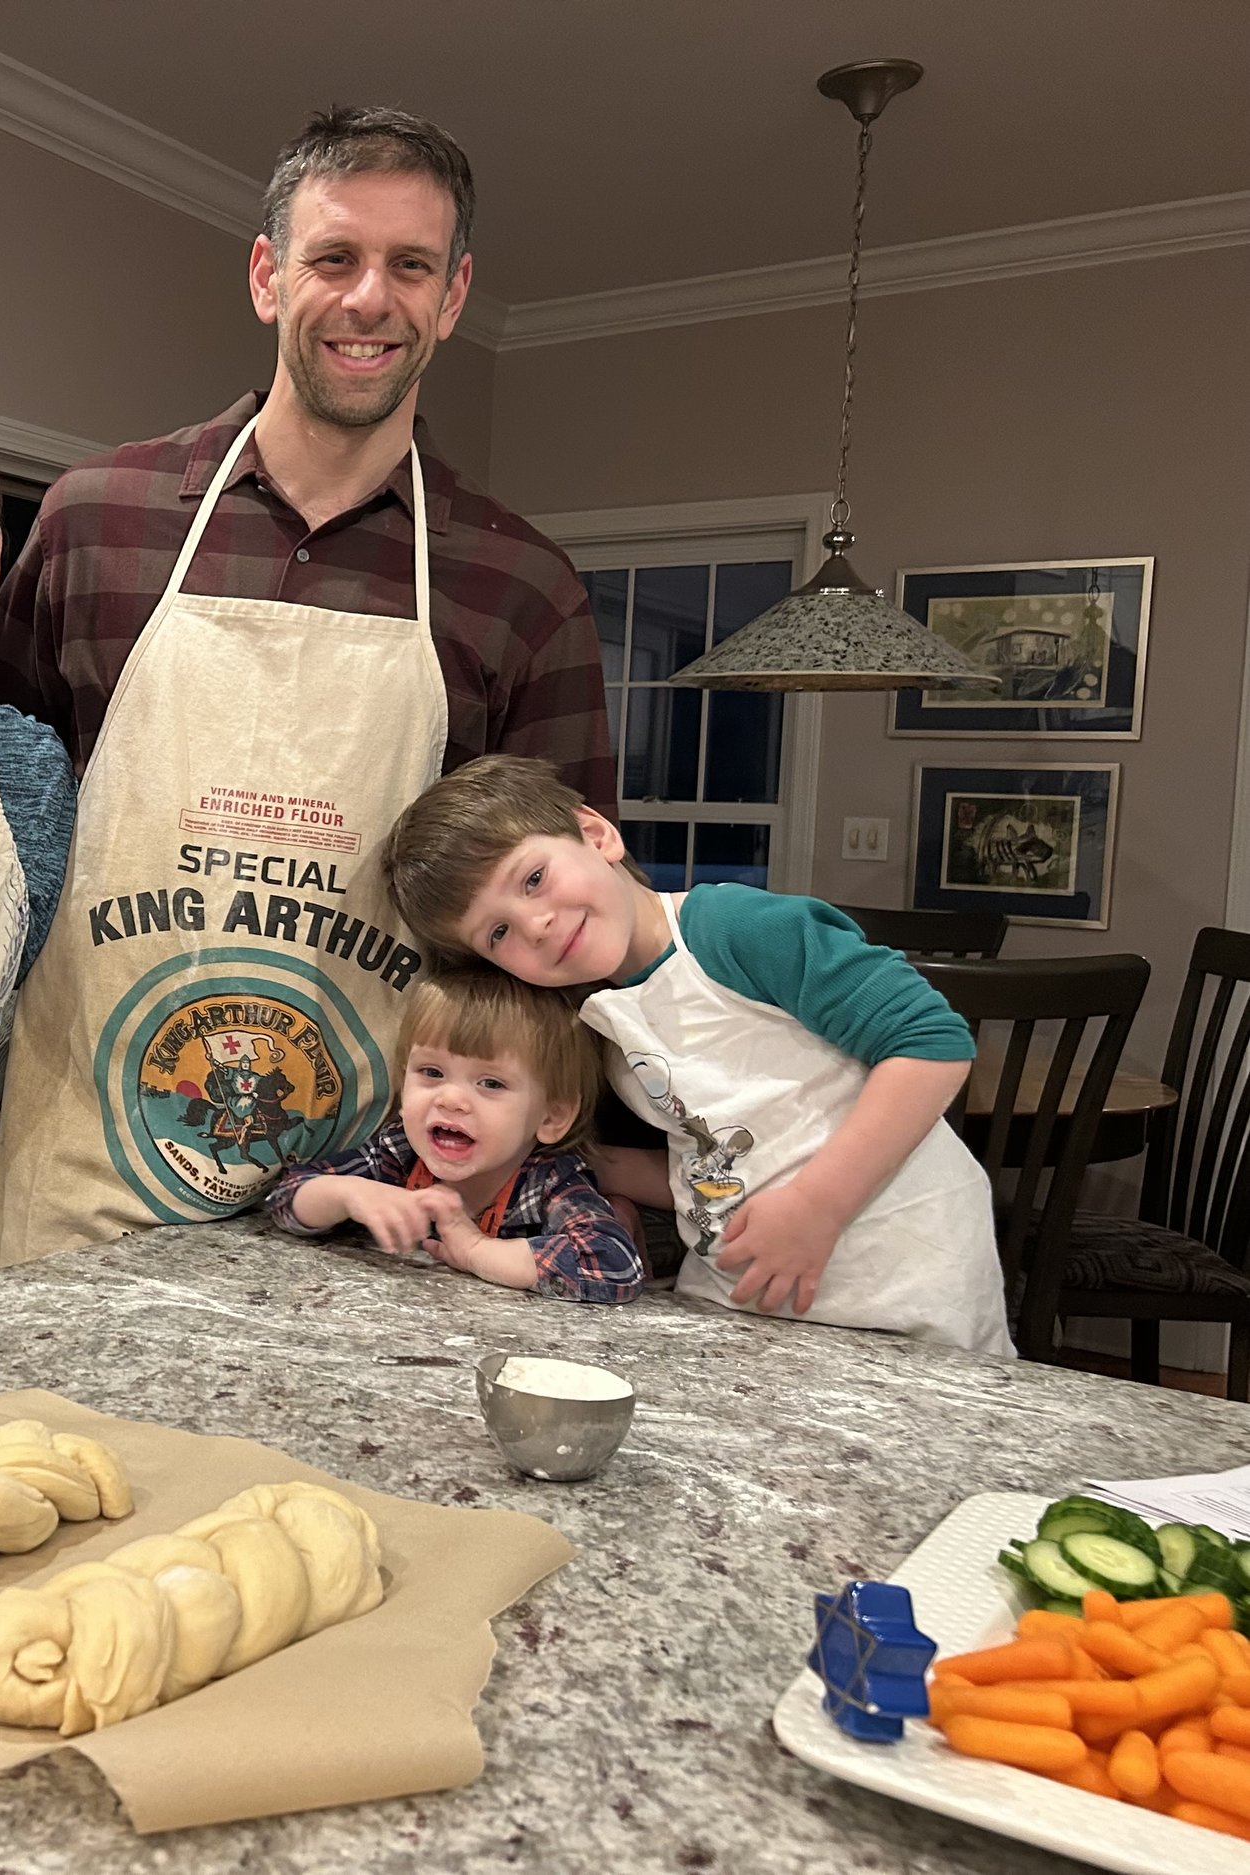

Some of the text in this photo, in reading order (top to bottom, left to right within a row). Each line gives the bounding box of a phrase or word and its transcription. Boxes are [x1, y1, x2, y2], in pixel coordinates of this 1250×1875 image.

[199, 797, 344, 827] ENRICHED FLOUR
[210, 787, 337, 811] VITAMIN AND MINERAL
[177, 843, 347, 895] SPECIAL
[88, 887, 422, 993] KING ARTHUR
[148, 1019, 191, 1075] KING
[188, 1001, 296, 1037] ARTHUR
[164, 1141, 201, 1181] SANDS,
[202, 1176, 248, 1199] TAYLOR
